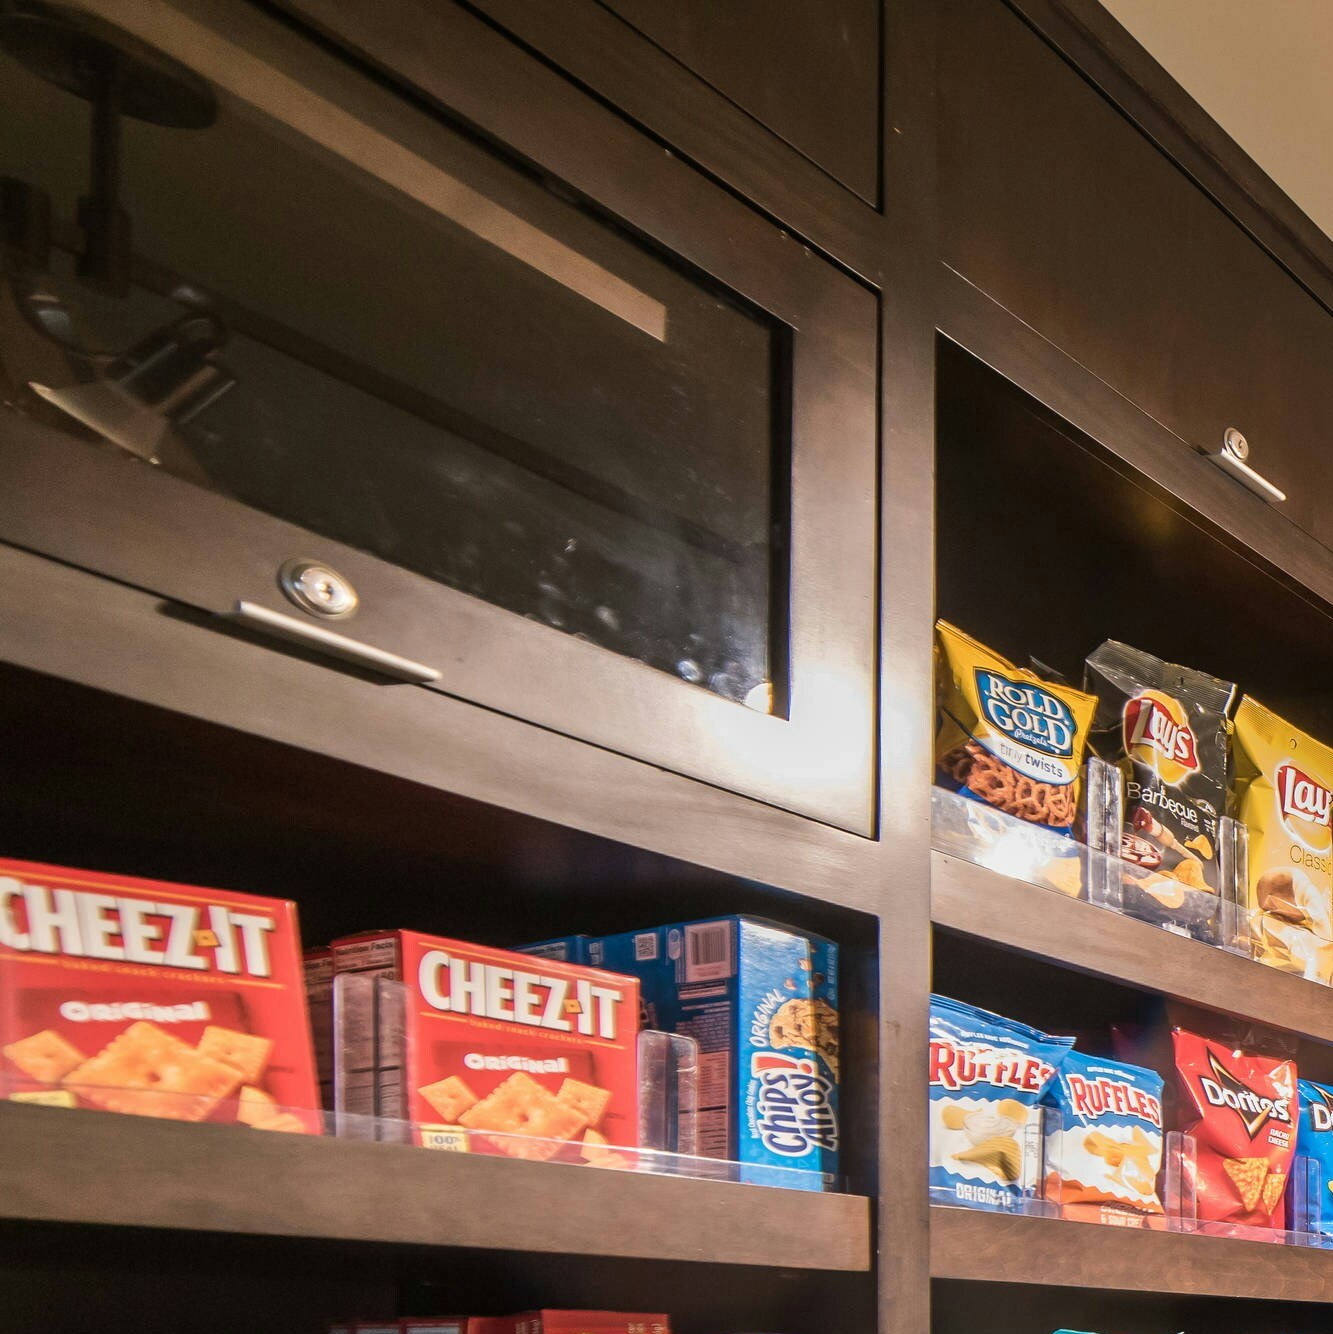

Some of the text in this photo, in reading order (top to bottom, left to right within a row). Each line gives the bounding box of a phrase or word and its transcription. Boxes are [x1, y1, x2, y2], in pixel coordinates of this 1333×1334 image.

[984, 674, 1064, 720] ROLD
[988, 699, 1071, 751] GOLD
[1130, 700, 1191, 760] Lay's
[1026, 754, 1063, 778] twists
[1127, 782, 1198, 822] Barbecue
[1284, 767, 1332, 826] Lay
[1290, 845, 1332, 875] Class
[749, 988, 787, 1048] ORIGINAL
[763, 1071, 806, 1154] Chips
[1069, 1077, 1162, 1127] RUFFLES
[1201, 1077, 1290, 1122] Doritos
